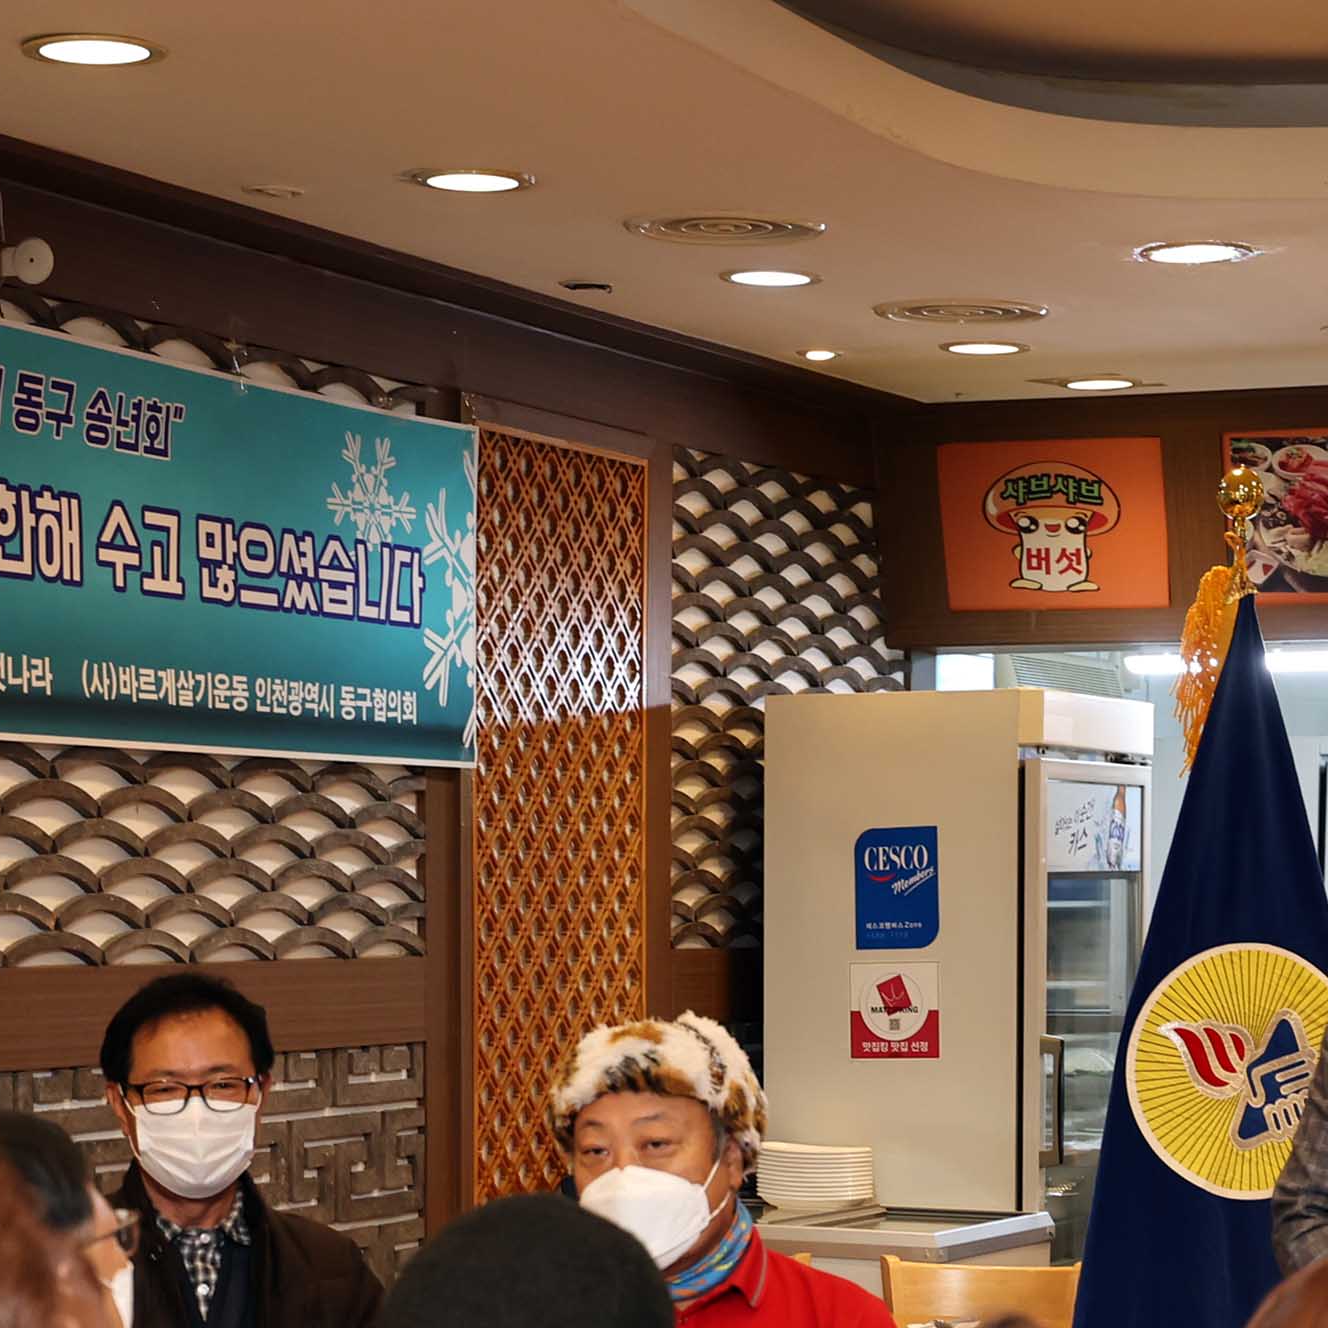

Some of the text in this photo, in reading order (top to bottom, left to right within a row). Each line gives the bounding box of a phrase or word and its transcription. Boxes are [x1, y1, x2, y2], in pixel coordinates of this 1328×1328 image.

[12, 369, 77, 440] 동구
[1000, 473, 1104, 506] 샤브샤브
[96, 498, 186, 599] 수고
[196, 513, 425, 627] 많으셨습니다
[1026, 547, 1083, 576] 버섯
[81, 659, 418, 725] (사)바르게살기운동 인천광역시 동구협의회
[864, 844, 928, 871] CESCO
